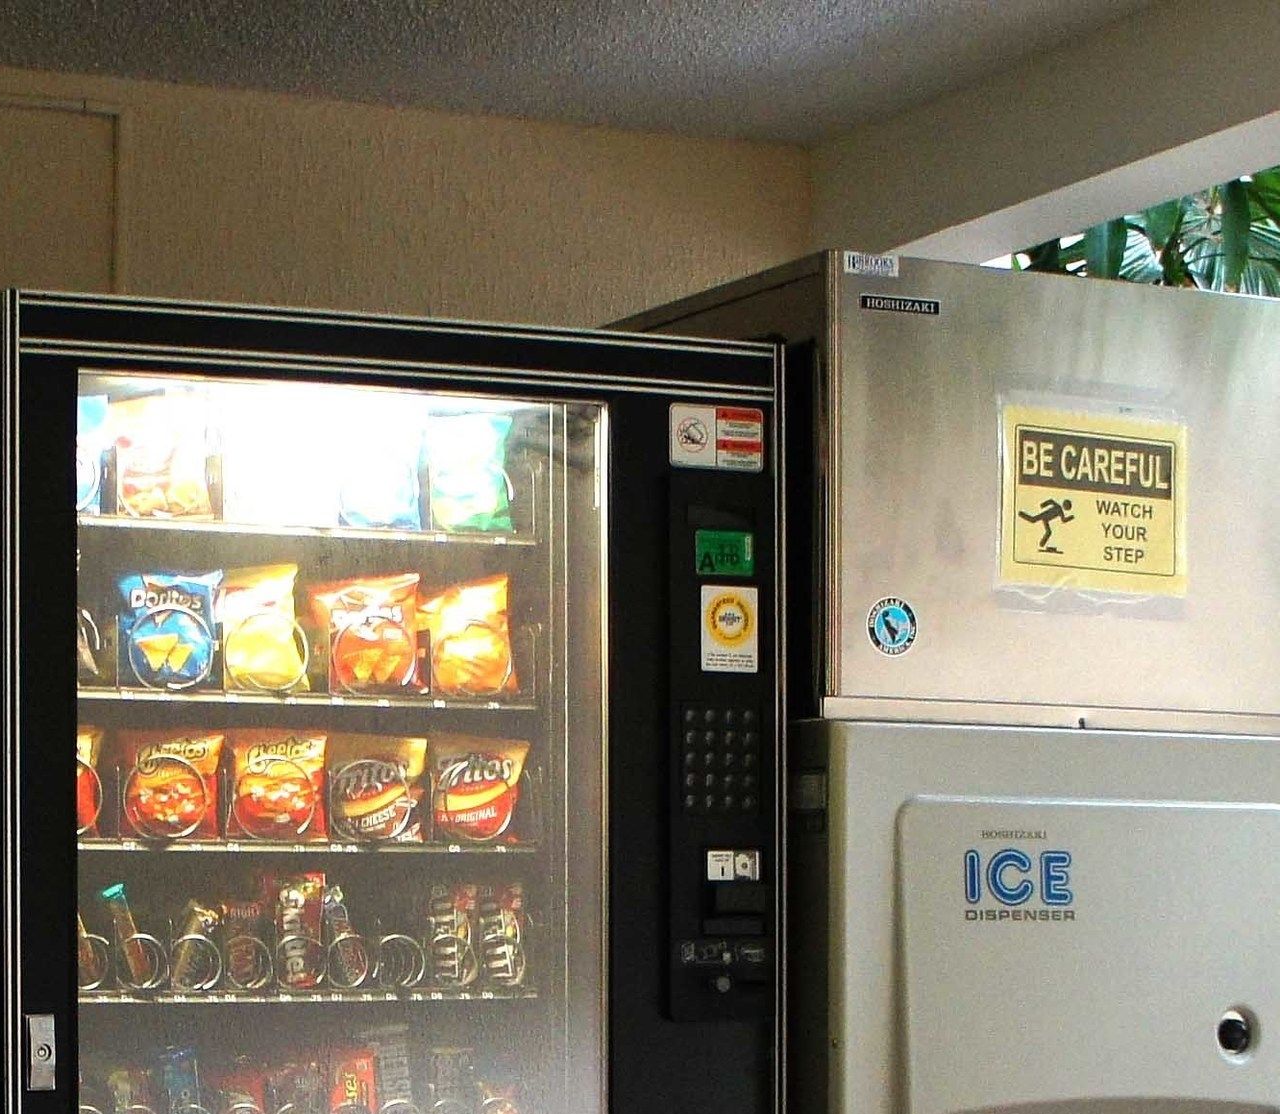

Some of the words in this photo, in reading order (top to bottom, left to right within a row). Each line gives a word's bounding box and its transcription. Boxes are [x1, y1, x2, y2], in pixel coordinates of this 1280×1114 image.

[866, 297, 935, 313] HOSHIZAKI
[1022, 440, 1054, 477] BE
[1061, 445, 1169, 489] CAREFUL
[1096, 500, 1153, 519] WATCH
[1101, 523, 1147, 542] YOUR
[1103, 546, 1145, 564] STEP
[130, 587, 202, 609] Doritos
[455, 805, 497, 823] ORIGINAL
[964, 848, 1074, 906] ICE
[965, 909, 1076, 921] DISPENSER
